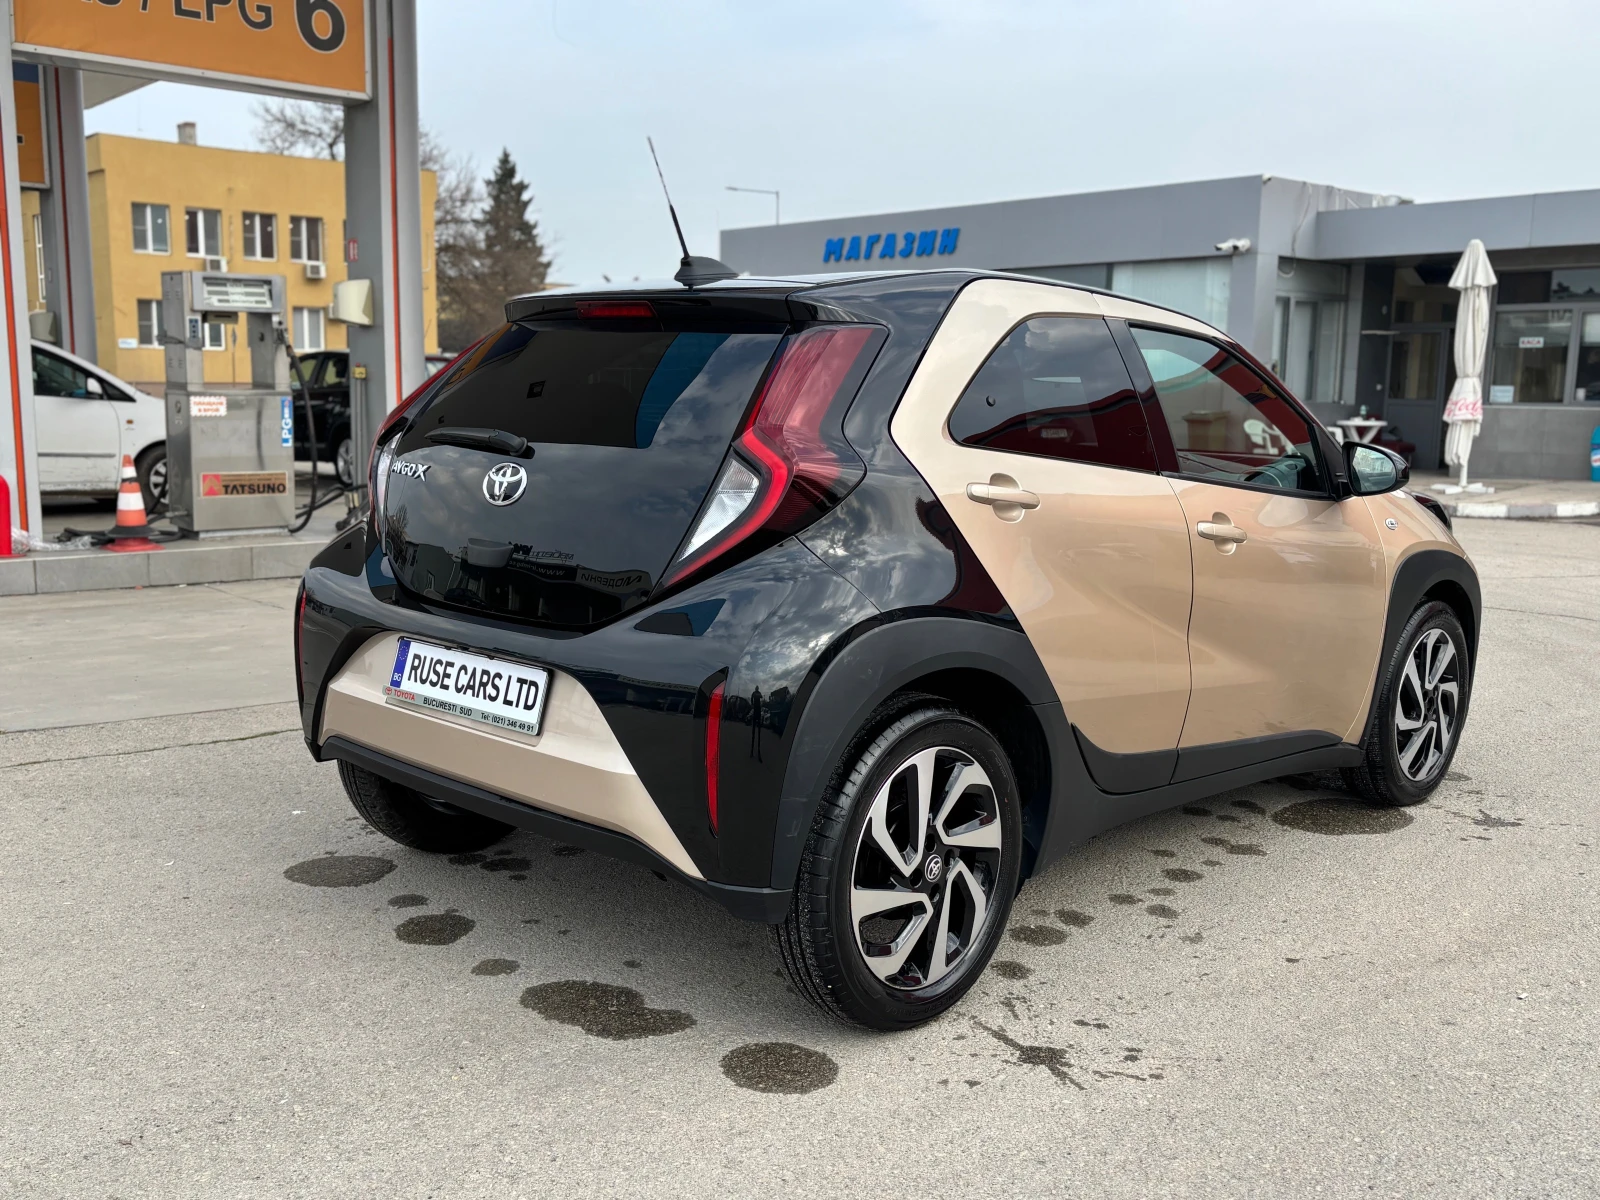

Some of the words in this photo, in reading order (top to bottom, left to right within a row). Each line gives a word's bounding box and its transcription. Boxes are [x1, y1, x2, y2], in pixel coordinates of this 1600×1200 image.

[293, 0, 348, 54] 6
[823, 227, 961, 264] МАГАЗИН
[281, 418, 293, 447] LPG
[222, 482, 286, 495] TATSUNO
[393, 672, 402, 682] BG
[407, 653, 455, 691] RUSE
[455, 664, 503, 702] CARS
[502, 675, 540, 711] LTD
[393, 689, 415, 701] TOYOTA
[423, 696, 457, 713] BUCURESTI
[459, 707, 473, 717] SUD
[491, 715, 506, 726] (021)
[518, 722, 526, 731] 49
[526, 724, 535, 733] 91
